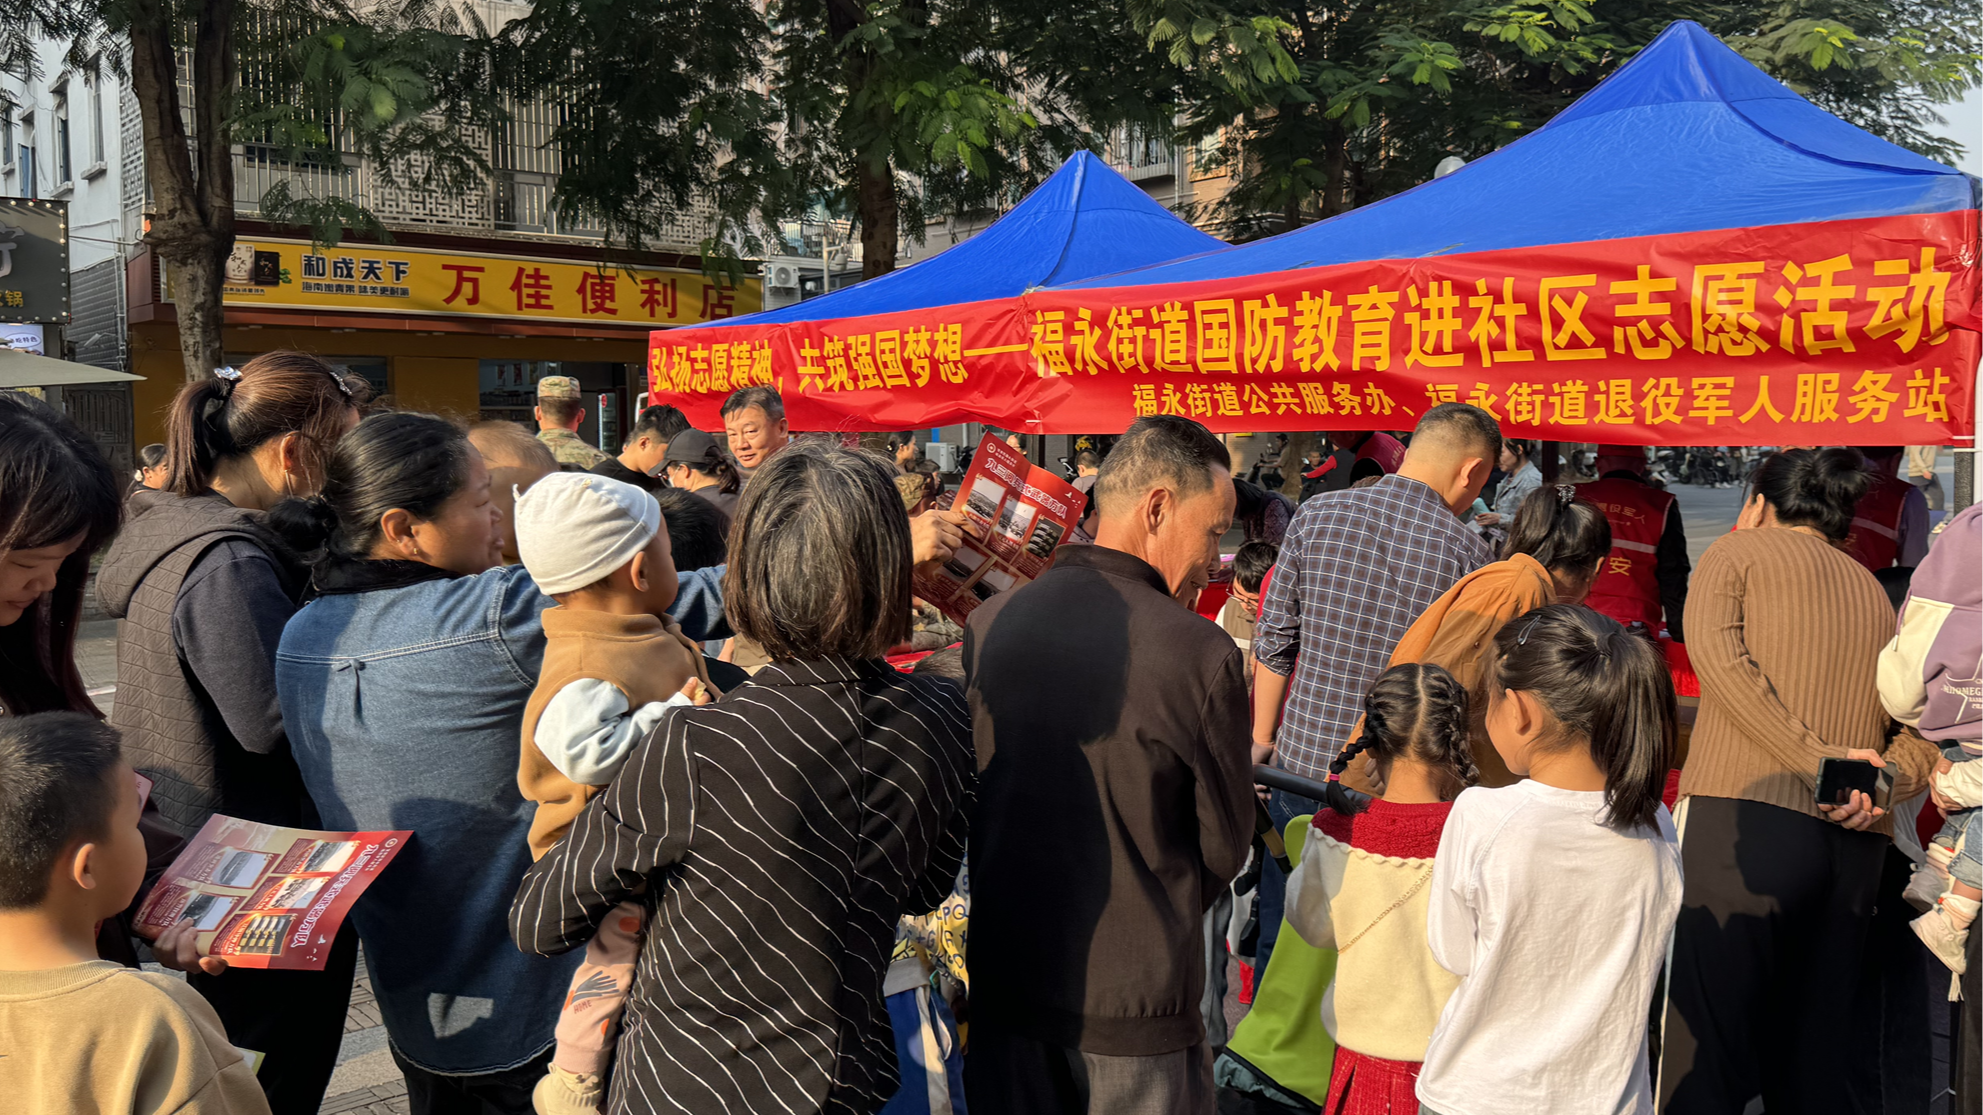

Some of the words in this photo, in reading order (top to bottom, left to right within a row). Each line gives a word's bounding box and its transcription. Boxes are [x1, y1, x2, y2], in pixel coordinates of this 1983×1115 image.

[302, 253, 410, 283] 和成天下
[441, 263, 735, 321] 万佳便利店
[1608, 557, 1632, 576] 安
